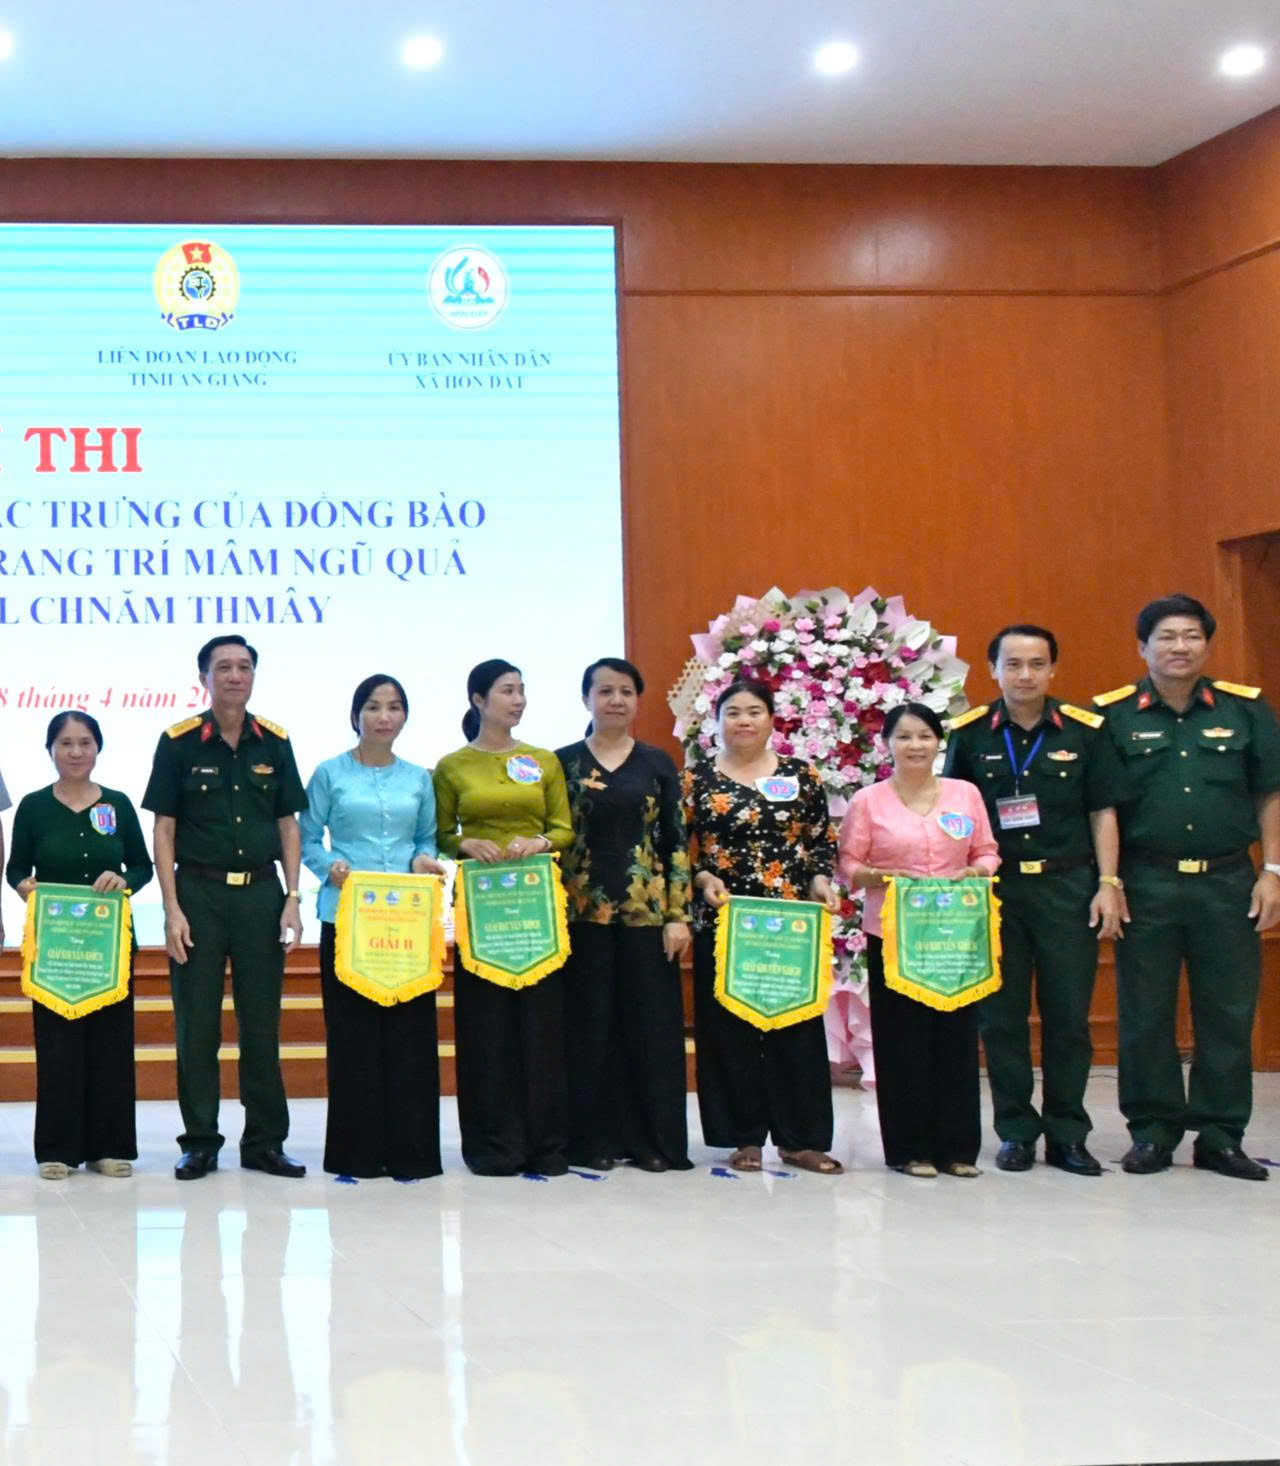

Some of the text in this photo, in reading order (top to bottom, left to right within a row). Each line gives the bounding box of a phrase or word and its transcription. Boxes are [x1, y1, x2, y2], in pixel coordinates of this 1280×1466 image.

[203, 350, 241, 364] LAO
[417, 352, 452, 366] BAN
[180, 373, 203, 386] AN
[207, 373, 267, 386] GIANG
[24, 426, 143, 473] THI
[43, 496, 181, 529] TRƯNG
[193, 491, 273, 529] CỦA
[284, 491, 394, 529] ĐỒNG
[407, 491, 486, 529] BÀO
[105, 539, 171, 577] TRÍ
[184, 538, 279, 577] MÂM
[292, 541, 373, 577] NGŨ
[385, 537, 467, 582] QUẢ
[29, 588, 176, 625] CHNĂM
[187, 586, 332, 625] THMÂY
[17, 685, 91, 713] tháng
[99, 687, 114, 708] 4
[121, 687, 177, 708] năm
